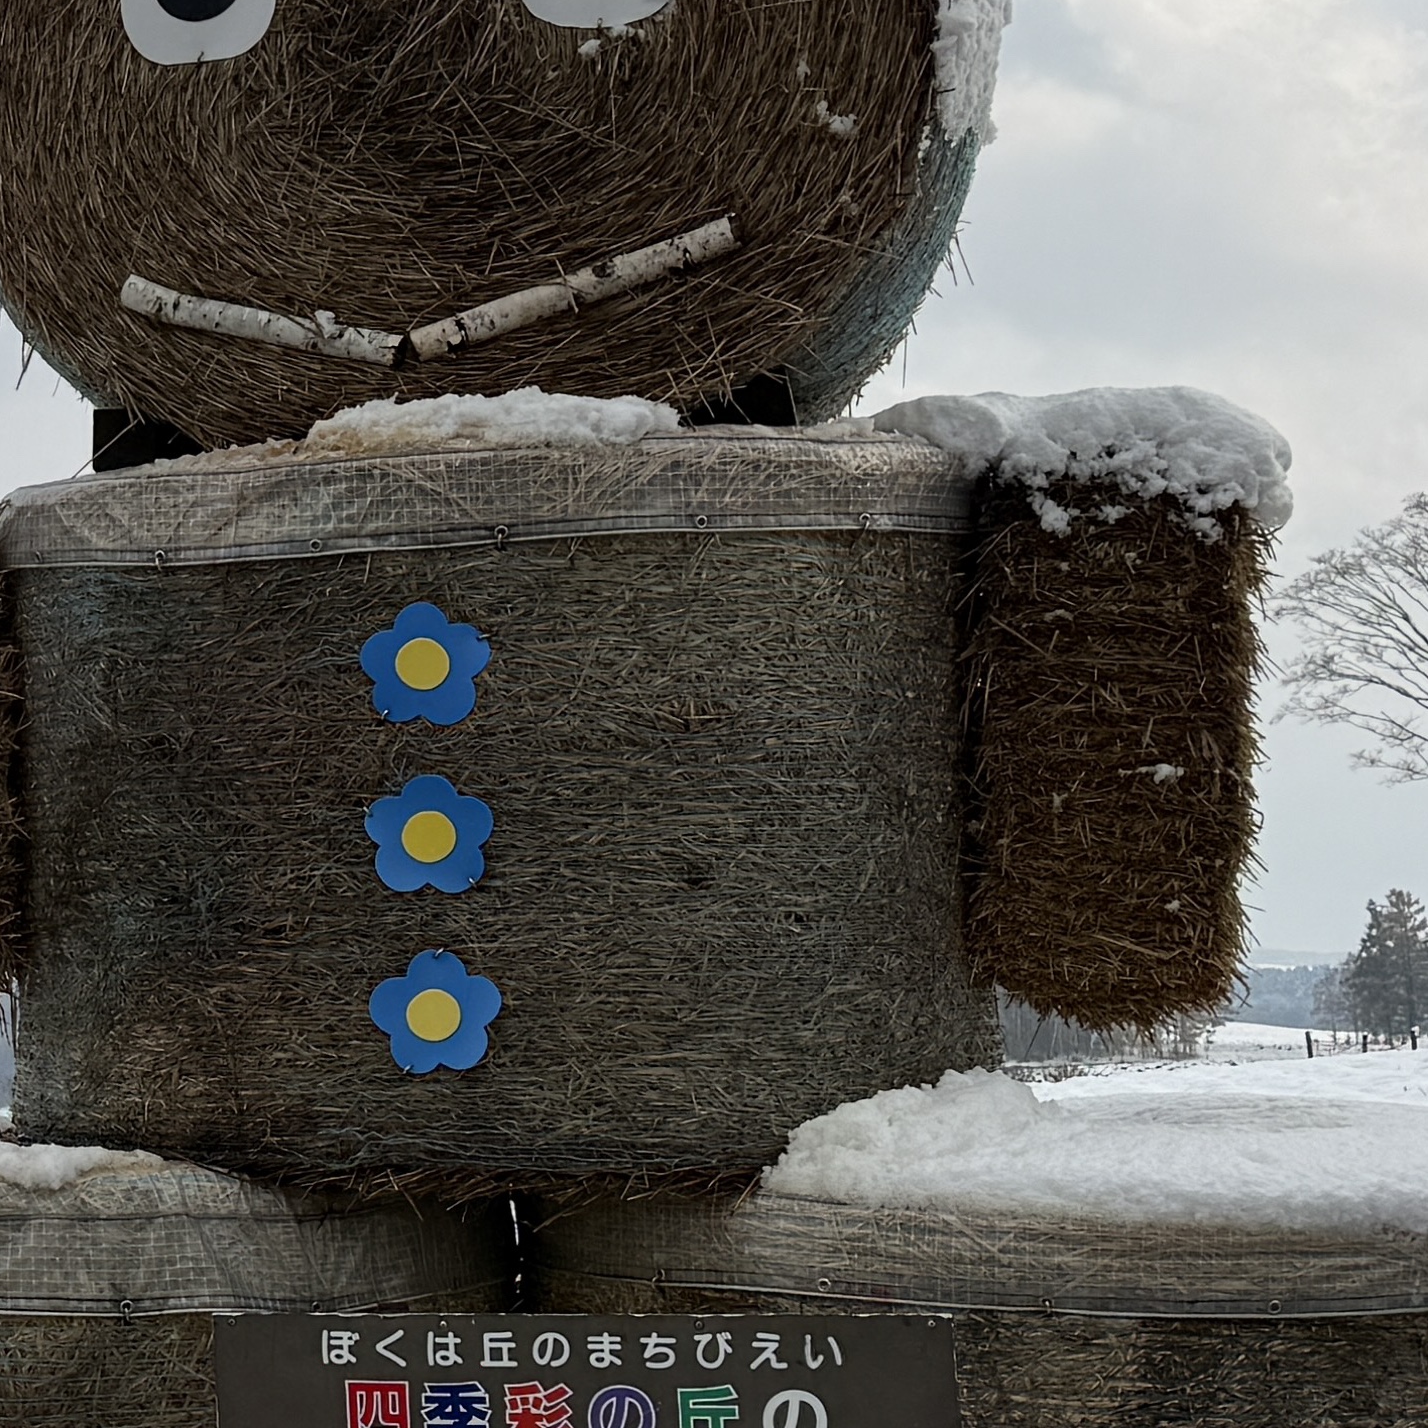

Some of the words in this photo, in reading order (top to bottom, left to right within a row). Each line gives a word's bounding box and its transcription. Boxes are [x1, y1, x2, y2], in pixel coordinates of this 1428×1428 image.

[321, 1329, 842, 1370] ぼくは丘のまちびえい
